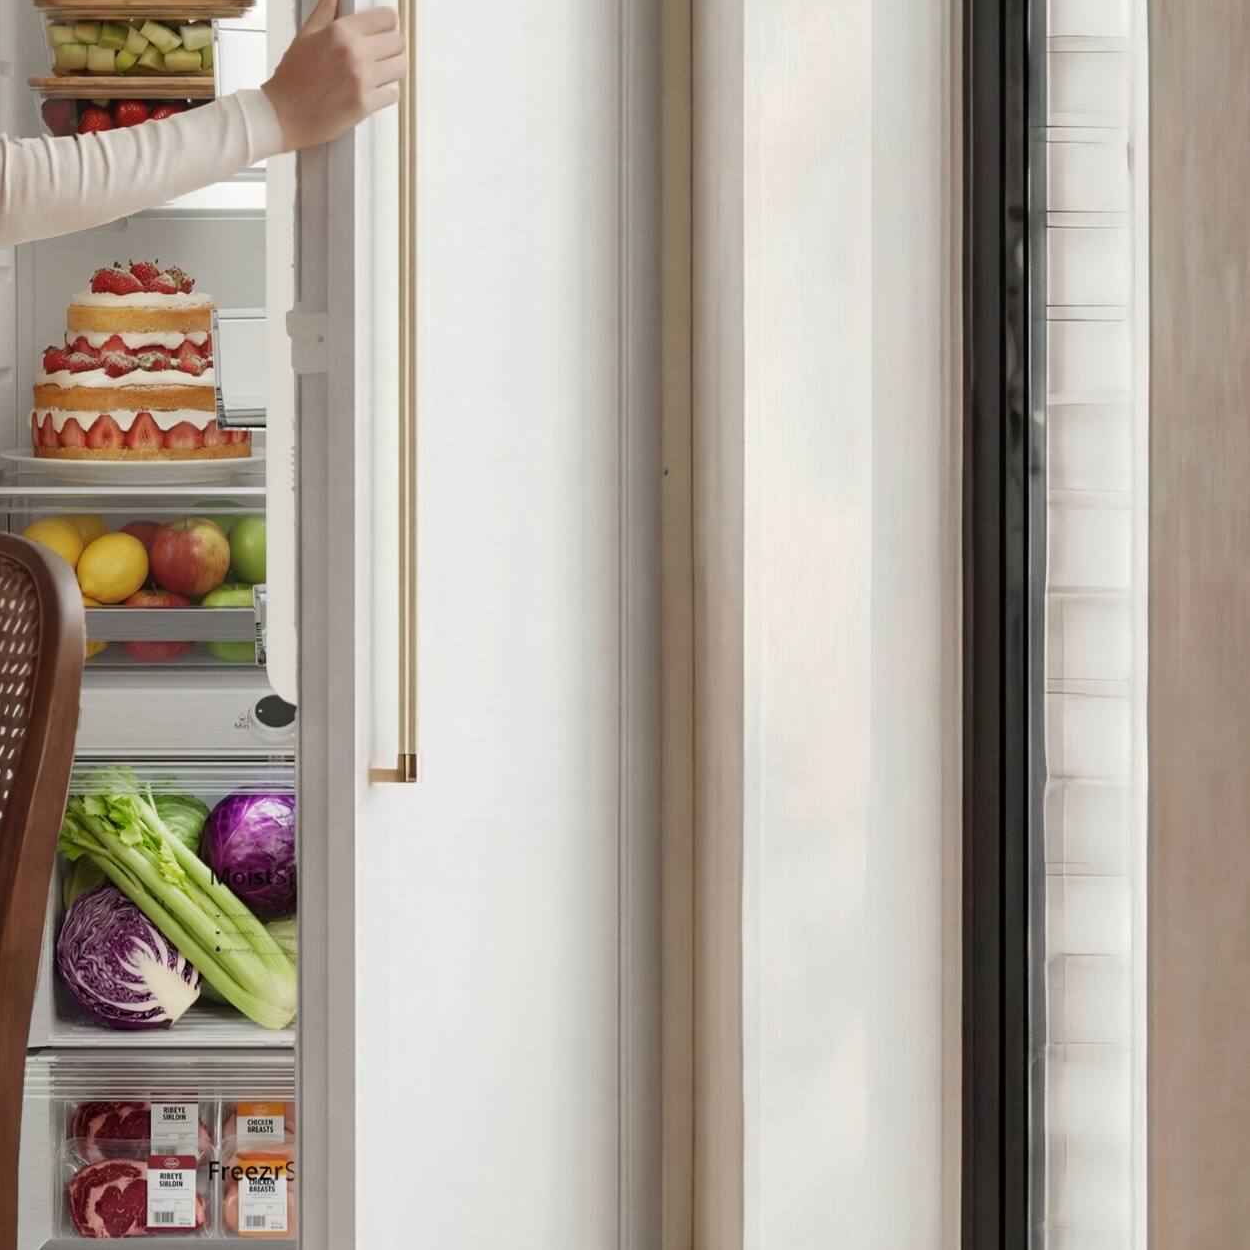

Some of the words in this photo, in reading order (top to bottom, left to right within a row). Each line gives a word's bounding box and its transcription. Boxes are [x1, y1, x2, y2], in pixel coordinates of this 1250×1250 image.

[163, 1106, 186, 1114] RIBEYE
[159, 1172, 183, 1180] RIBEYE
[249, 1185, 276, 1193] BREASTS
